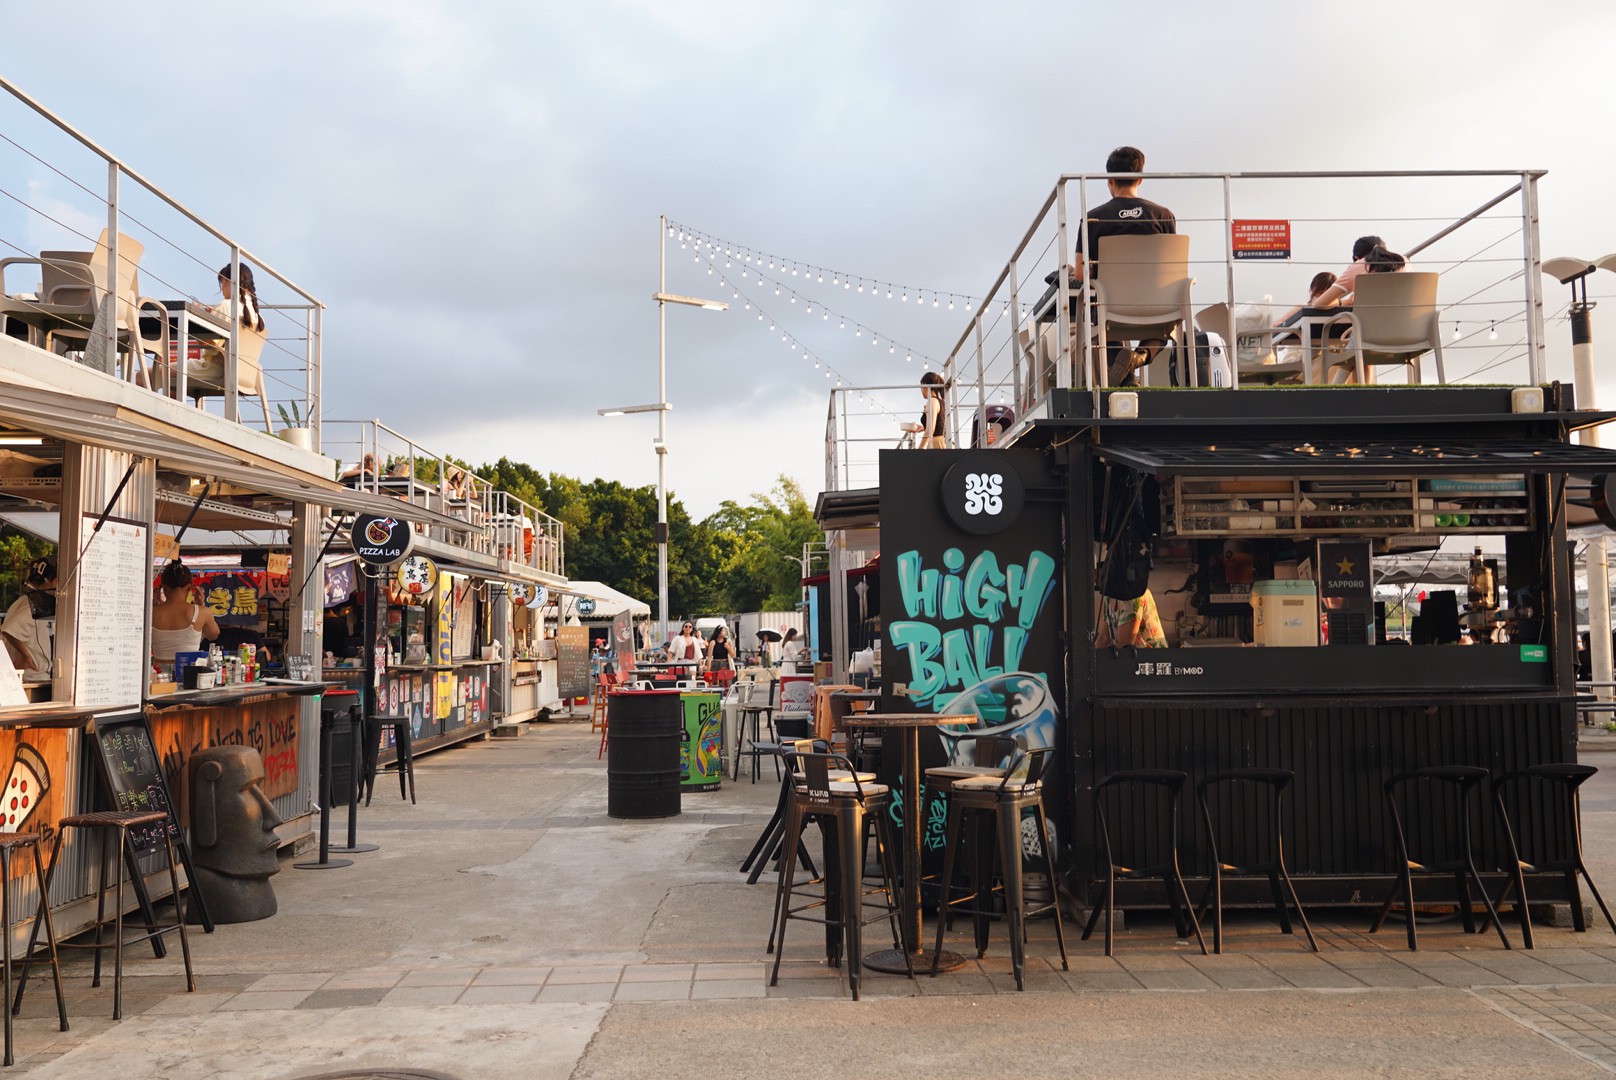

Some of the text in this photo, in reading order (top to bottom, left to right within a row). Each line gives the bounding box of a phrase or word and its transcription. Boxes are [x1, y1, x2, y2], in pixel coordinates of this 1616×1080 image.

[359, 547, 401, 556] PIZZA LAB
[1328, 580, 1365, 588] SAPPORO
[187, 587, 258, 617] き鳥
[1135, 662, 1172, 676] 庫羅
[269, 715, 296, 748] LOVE
